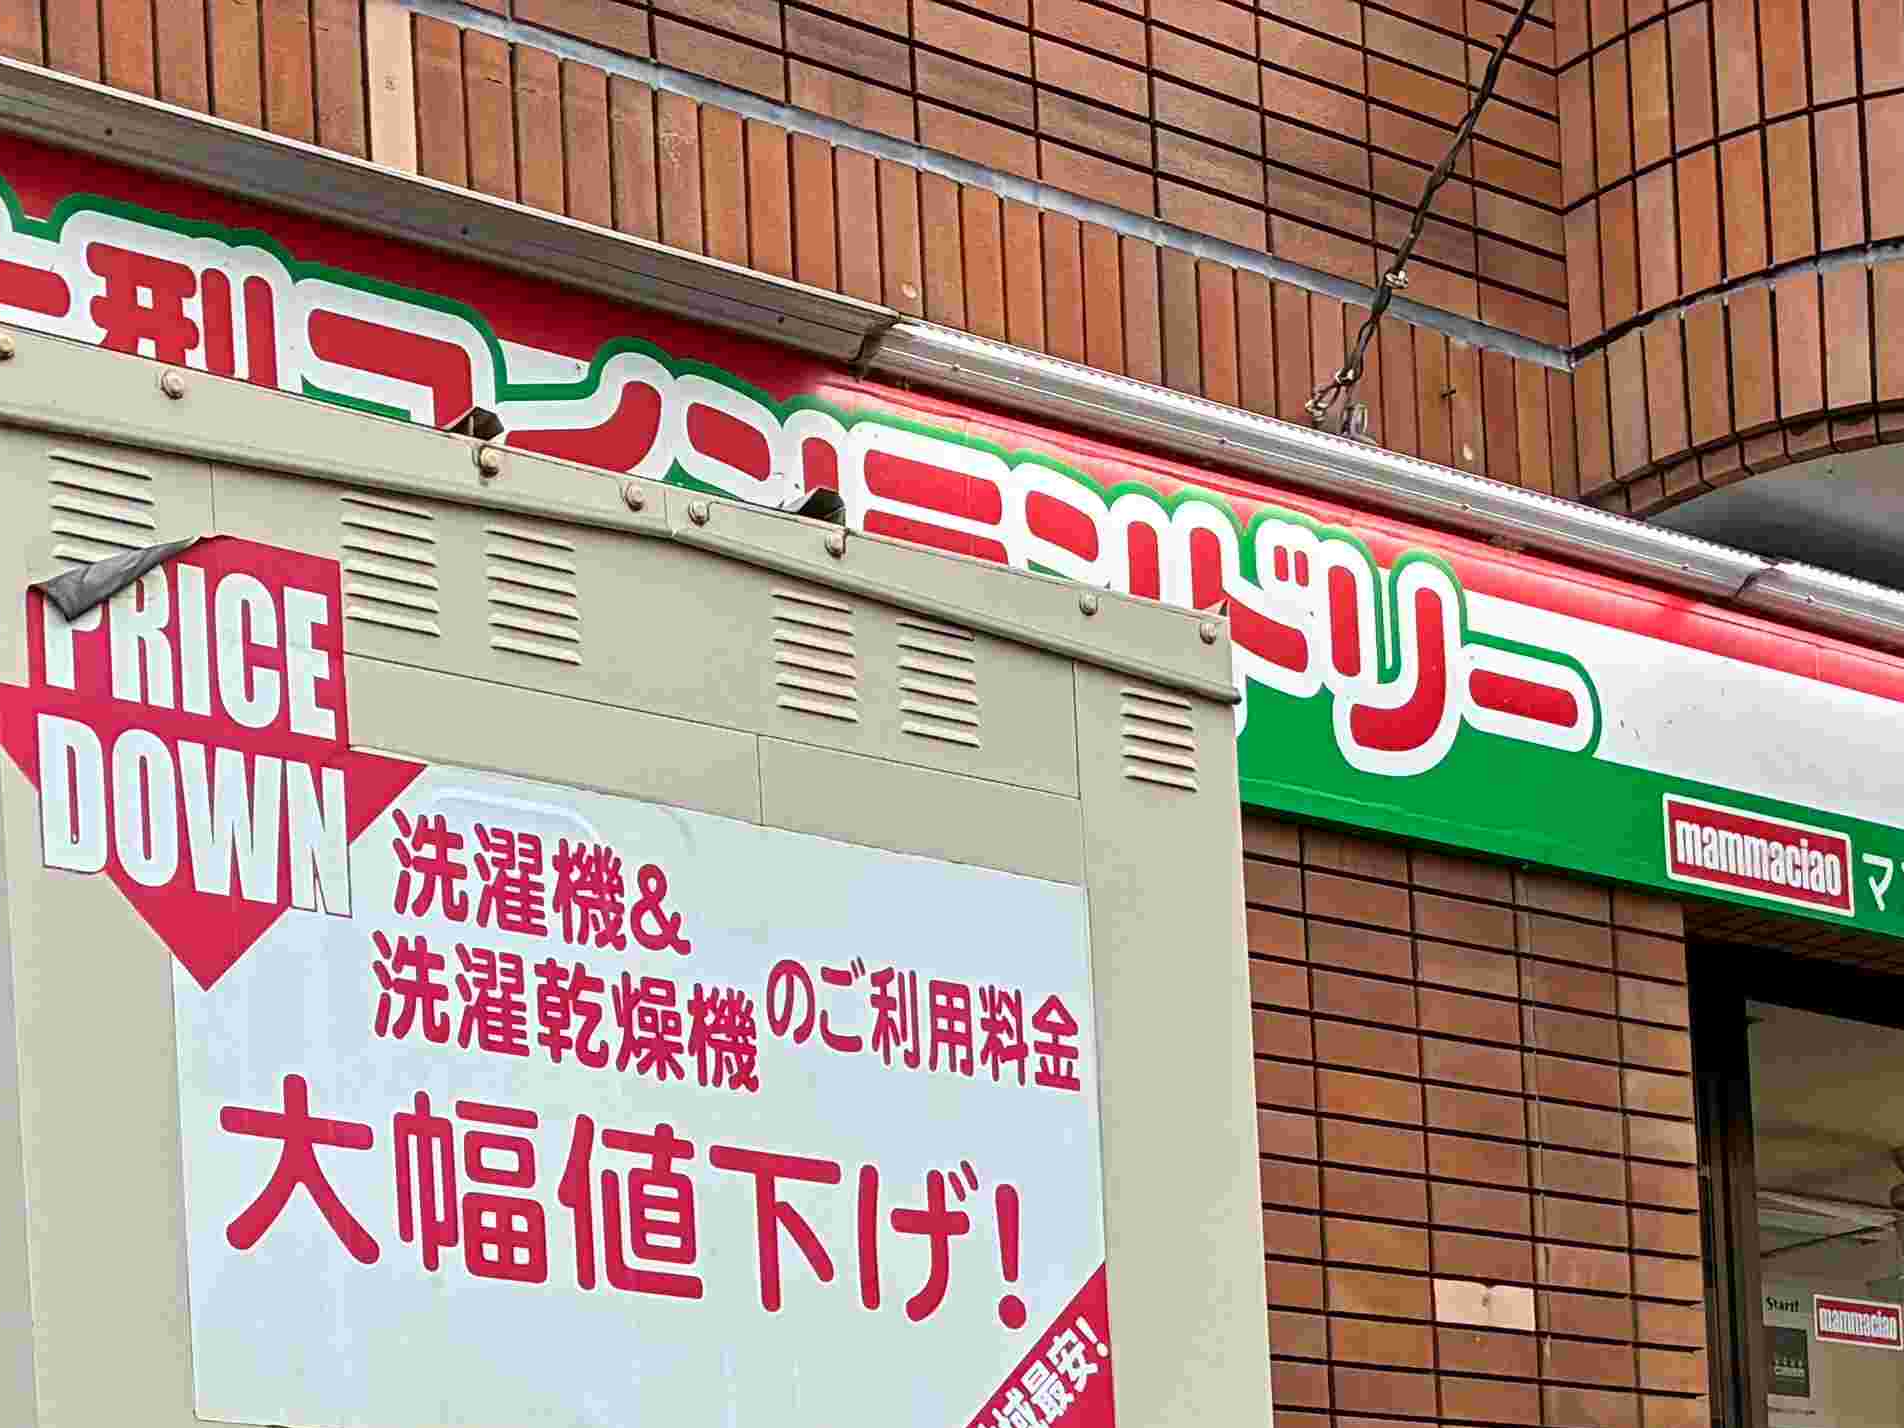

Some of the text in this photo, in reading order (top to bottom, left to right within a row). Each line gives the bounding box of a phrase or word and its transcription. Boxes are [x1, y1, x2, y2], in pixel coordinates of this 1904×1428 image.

[45, 562, 337, 742] PRICE
[37, 713, 352, 919] DOWN
[392, 808, 691, 956] 洗濯機&
[1675, 818, 1842, 898] mammaciao
[219, 1073, 1028, 1330] 大幅値下げ!
